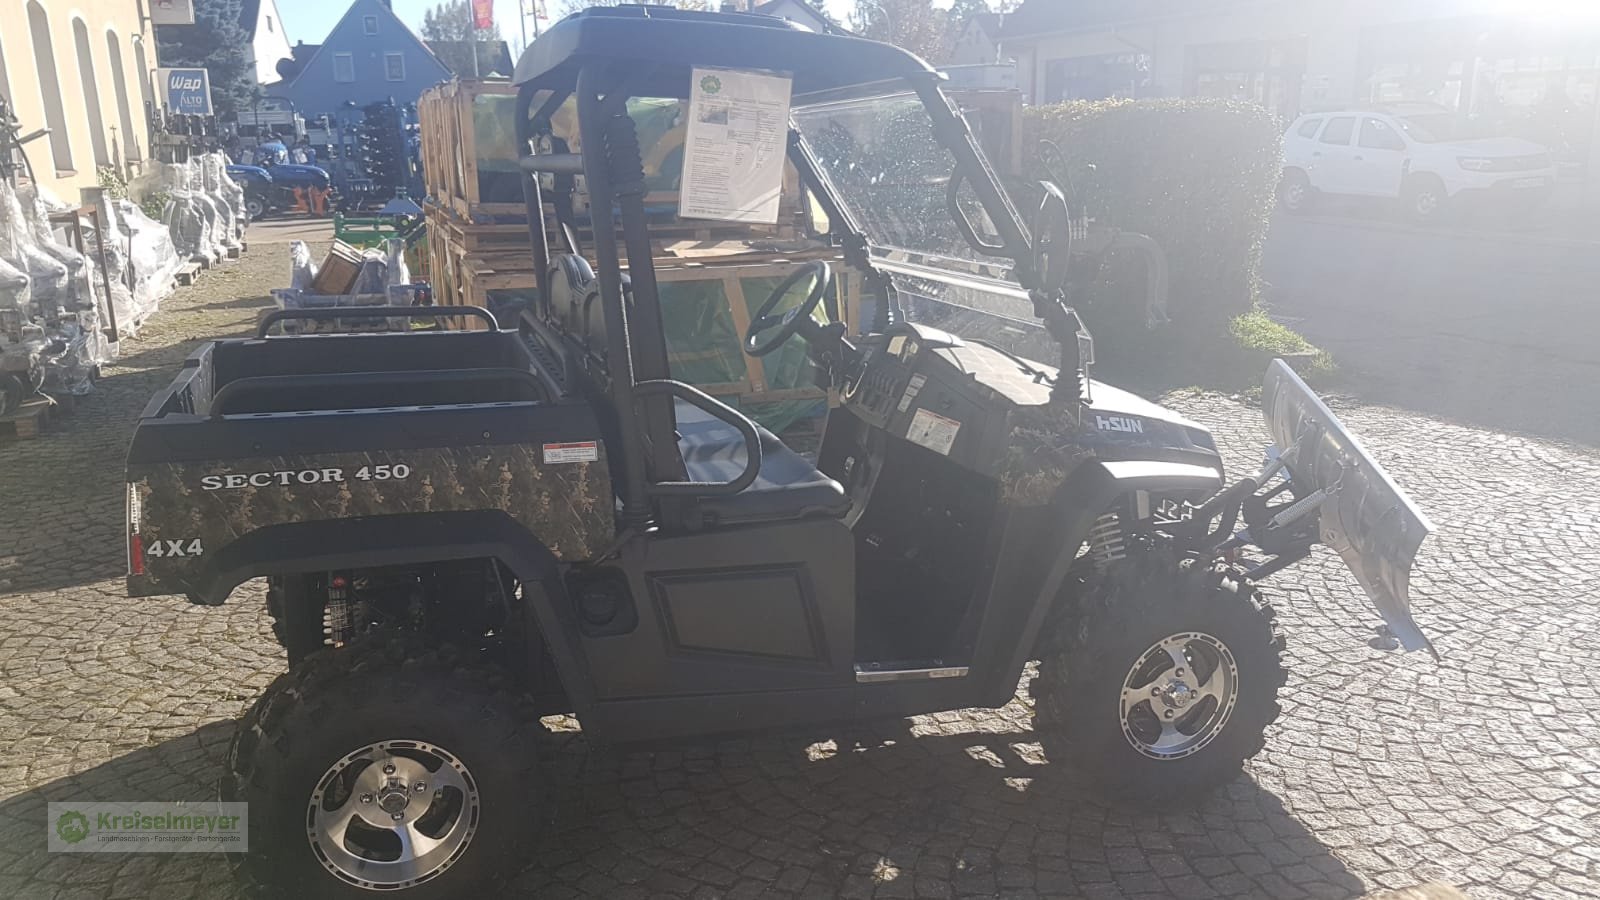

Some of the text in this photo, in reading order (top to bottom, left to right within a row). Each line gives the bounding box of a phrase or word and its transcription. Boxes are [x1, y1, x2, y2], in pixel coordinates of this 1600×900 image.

[171, 76, 202, 91] Wap
[201, 464, 410, 490] SECTOR 450
[147, 538, 204, 558] 4X4
